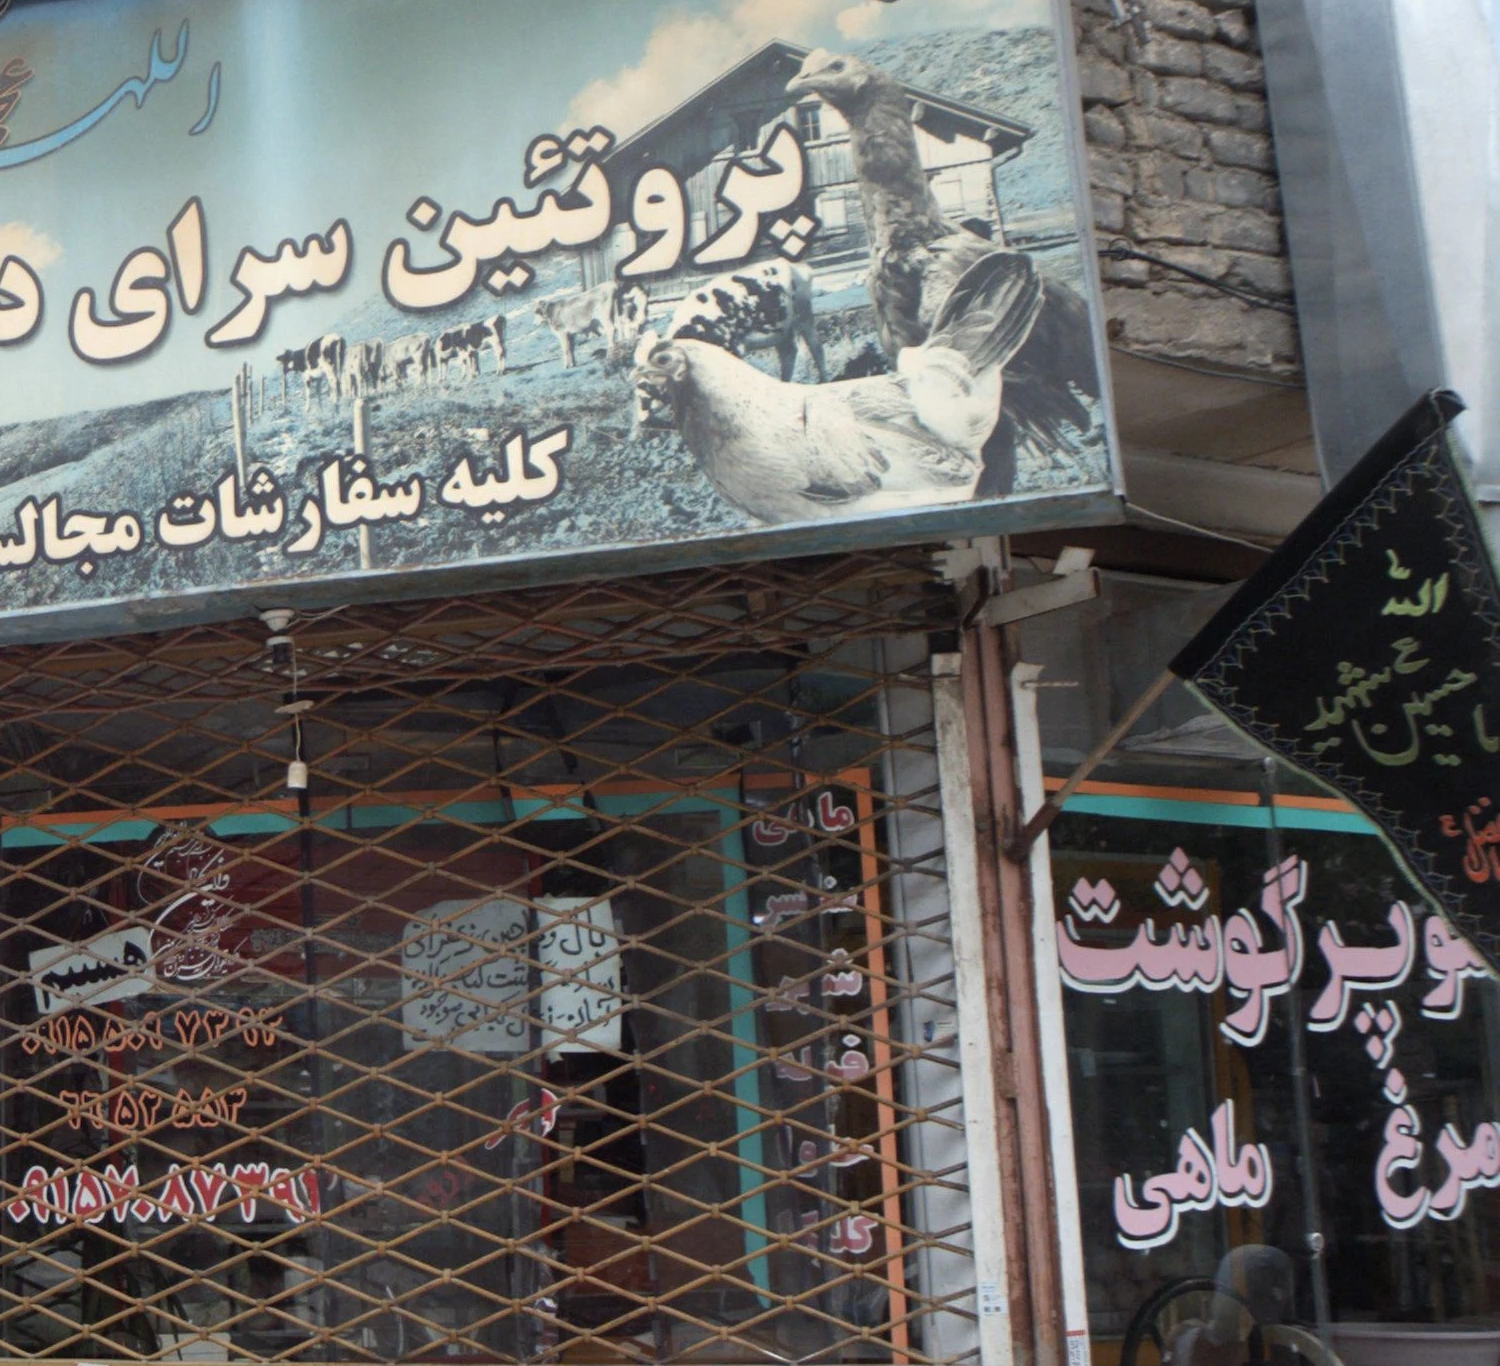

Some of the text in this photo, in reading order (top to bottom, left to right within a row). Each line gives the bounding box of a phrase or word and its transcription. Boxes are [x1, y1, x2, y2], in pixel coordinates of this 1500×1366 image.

[68, 195, 355, 365] سرای
[382, 121, 822, 310] پروتئین
[154, 457, 425, 555] سفارشات
[438, 428, 570, 523] کلیه
[1306, 899, 1498, 1070] وپر
[1113, 1067, 1500, 1250] مرغ ماهی
